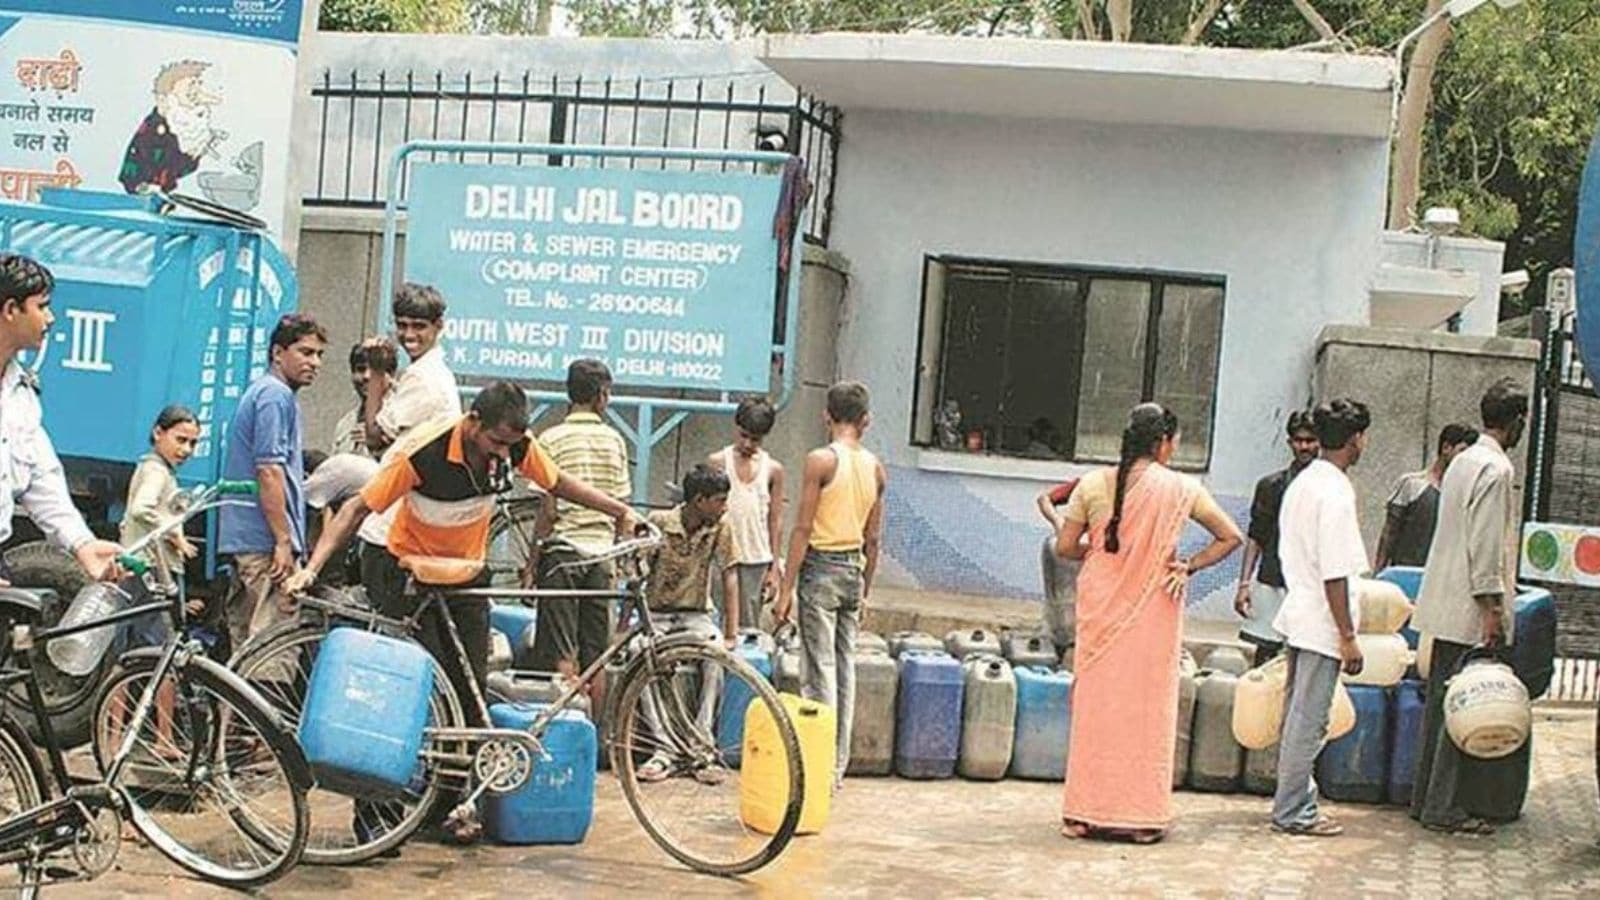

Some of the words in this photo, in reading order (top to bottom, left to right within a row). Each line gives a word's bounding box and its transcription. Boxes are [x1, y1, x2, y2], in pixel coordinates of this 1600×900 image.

[47, 104, 95, 123] समय
[13, 132, 45, 150] नल
[52, 129, 70, 152] से
[465, 184, 556, 221] DELHI
[562, 187, 626, 225] JAL
[632, 189, 743, 231] BOARD
[449, 229, 516, 253] WATER
[522, 231, 539, 255] &
[545, 234, 616, 259] SEWER
[622, 238, 742, 264] EMERGENCY
[443, 318, 498, 342] OUTH
[505, 320, 570, 347] WEST
[580, 325, 610, 350] III
[624, 328, 725, 357] DIVISION
[479, 347, 552, 370] PURAM
